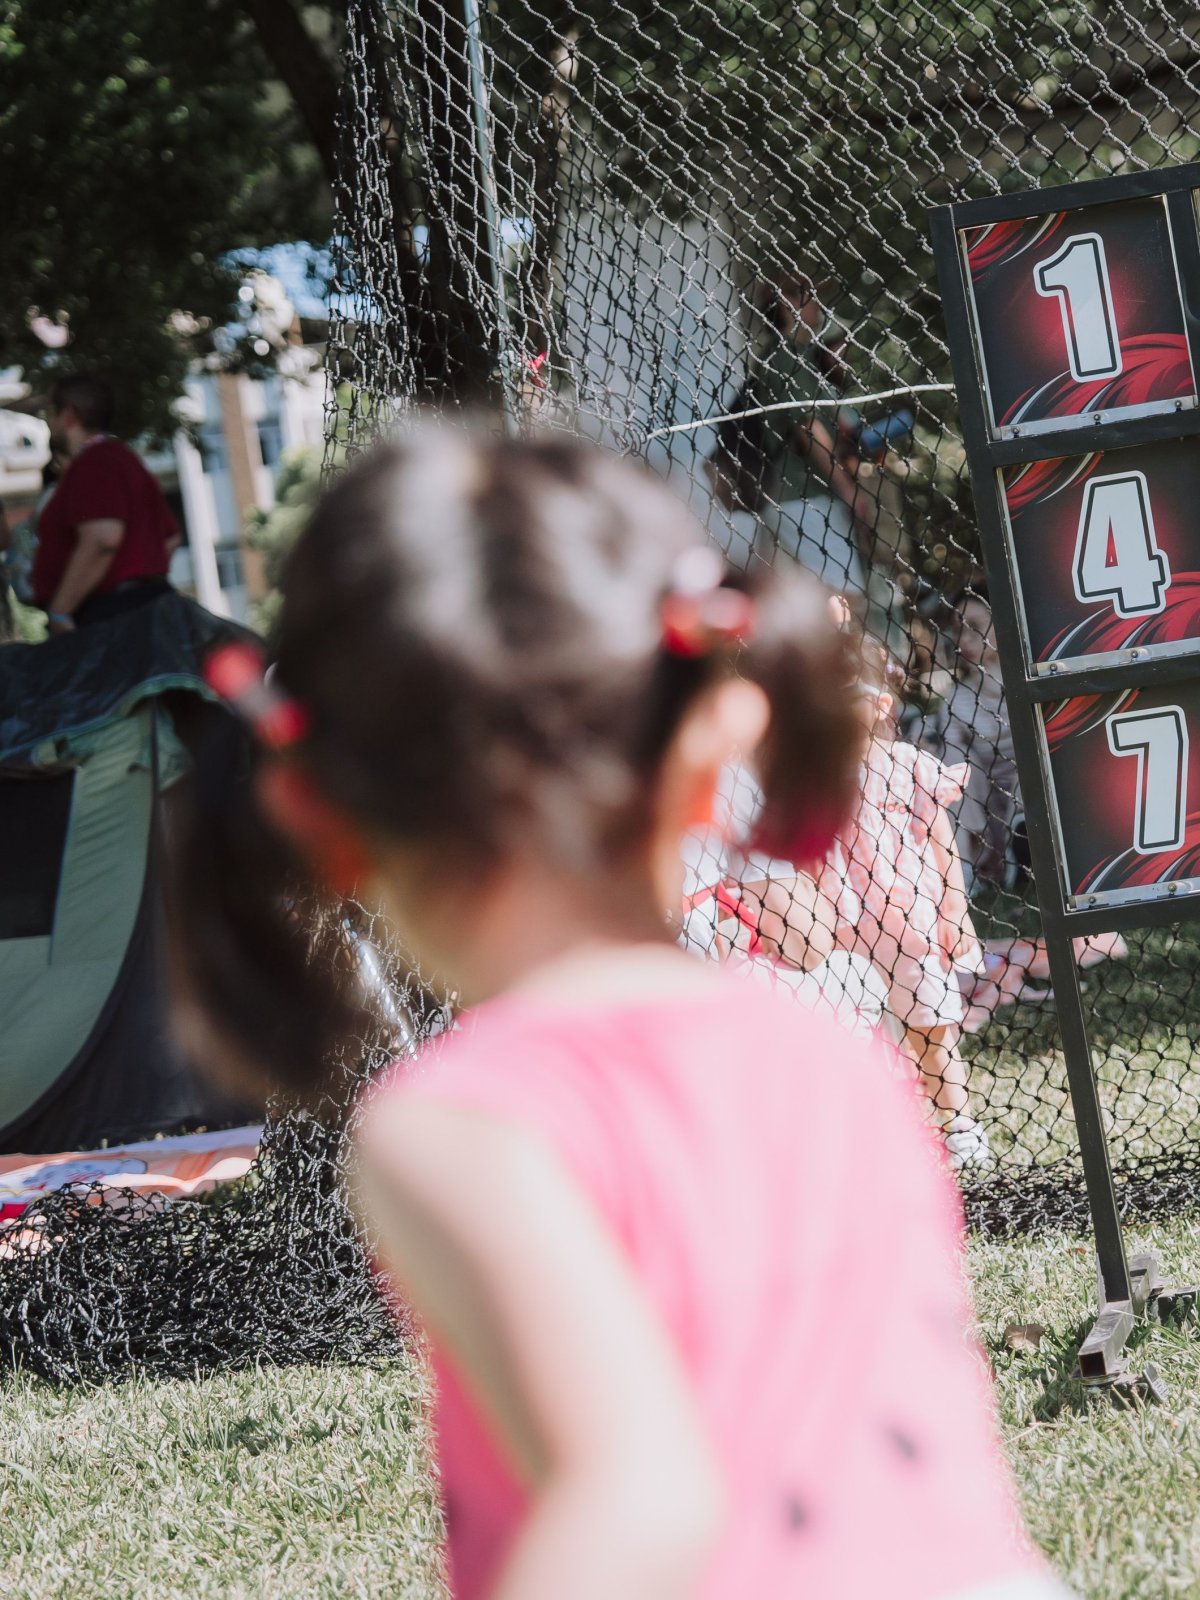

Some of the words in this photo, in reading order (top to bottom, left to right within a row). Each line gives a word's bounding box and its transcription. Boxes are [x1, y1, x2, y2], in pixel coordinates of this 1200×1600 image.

[1034, 232, 1123, 382] 1
[1071, 471, 1171, 619] 4
[1106, 704, 1188, 855] 7
